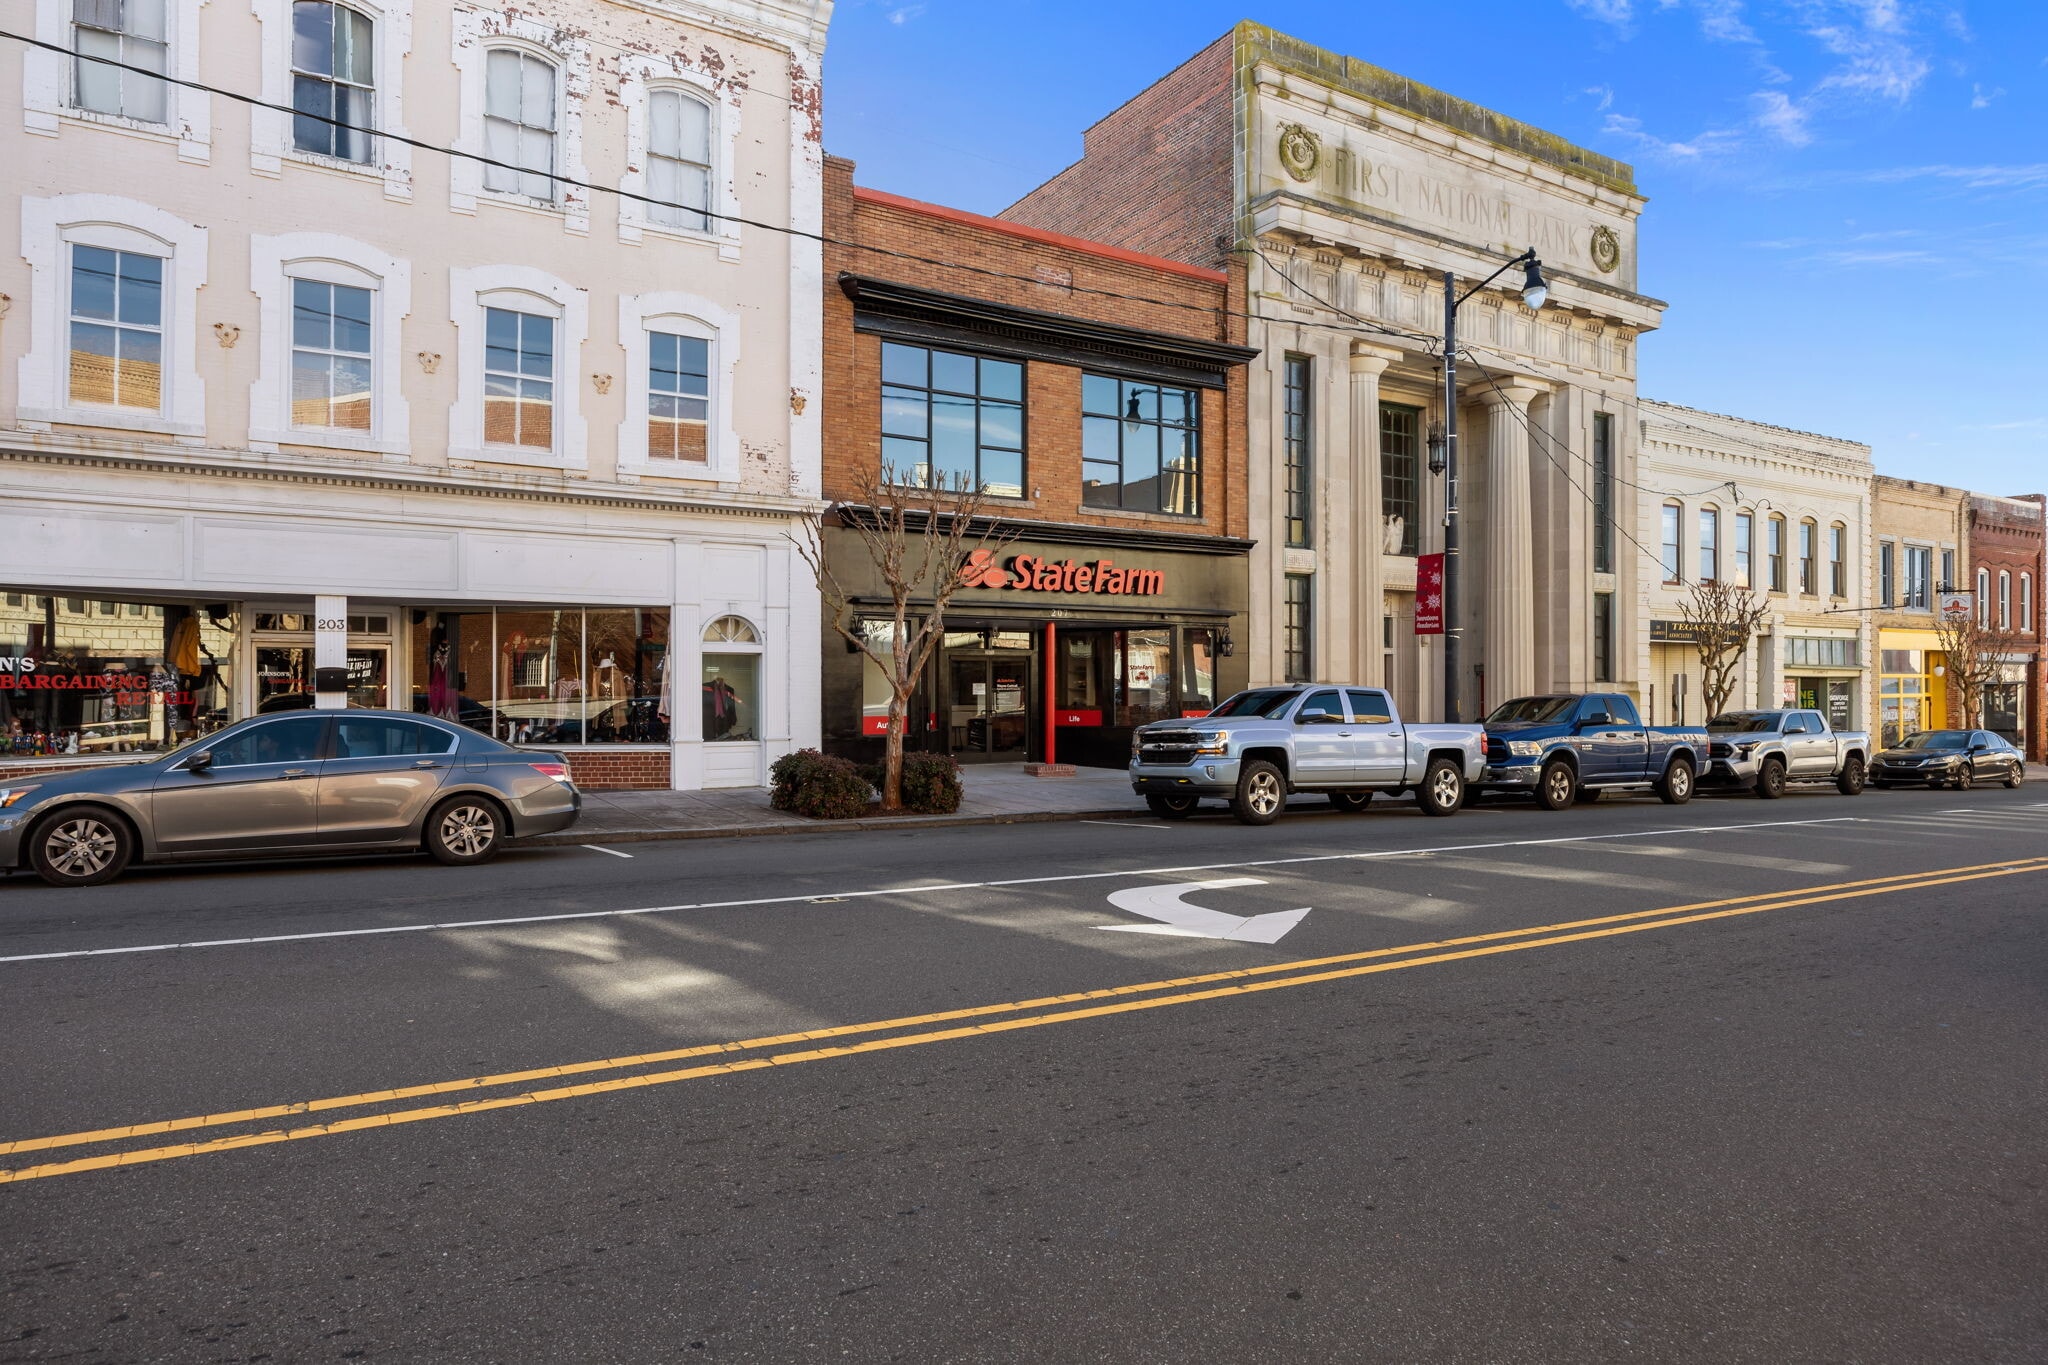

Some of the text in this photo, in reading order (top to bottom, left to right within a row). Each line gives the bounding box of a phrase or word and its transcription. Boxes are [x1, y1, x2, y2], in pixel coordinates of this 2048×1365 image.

[1335, 148, 1580, 258] FIRST NATIONAL BANK
[1051, 608, 1069, 617] 207
[318, 618, 345, 630] 203
[0, 674, 149, 689] BARGAINING
[116, 691, 196, 705] RETAIL
